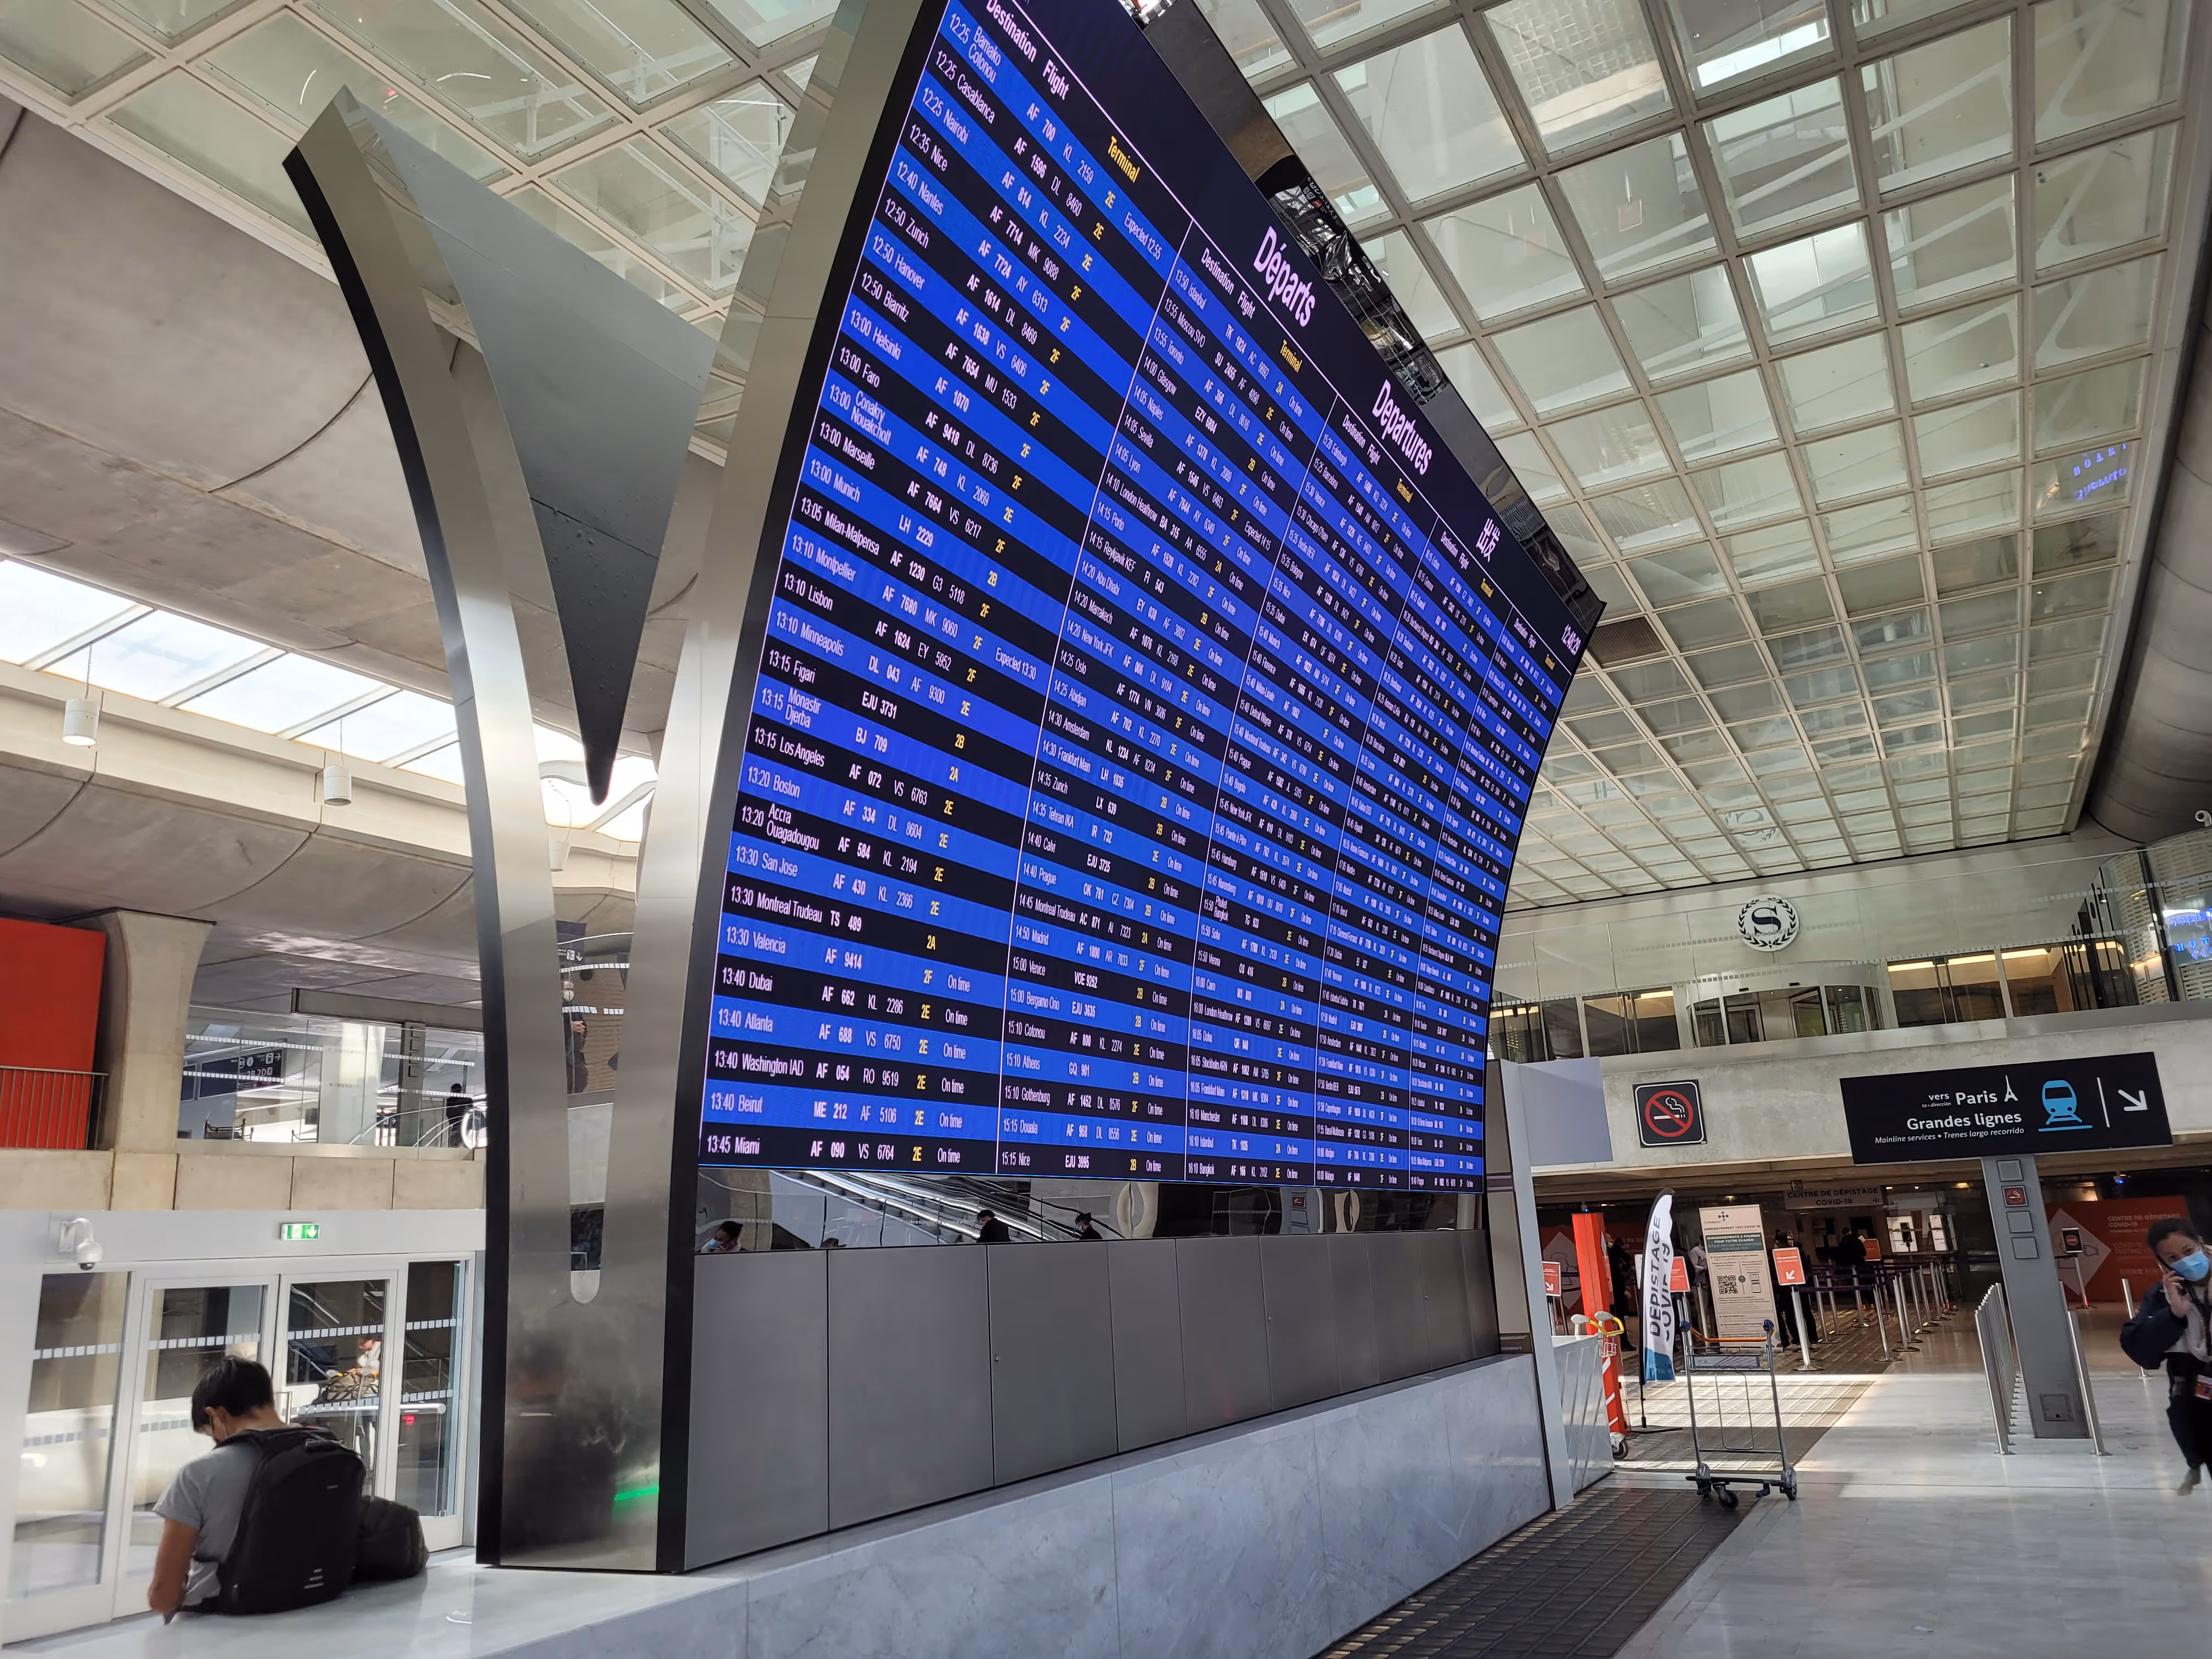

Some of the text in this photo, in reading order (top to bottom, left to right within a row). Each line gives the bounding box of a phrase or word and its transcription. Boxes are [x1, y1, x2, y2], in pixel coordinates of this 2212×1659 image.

[968, 43, 997, 83] Cotonou
[986, 0, 1140, 183] Destination Flight Terminal
[936, 50, 1104, 240] 12:25 Casablanca AF 1596 DL 8460 2E
[950, 13, 1163, 260] 12:25 Bamako AF 700 KL 2159 2E Expected 12:55
[1253, 225, 1316, 327] Départs
[1201, 247, 1302, 373] Destination Flight Terminal
[1372, 379, 1432, 475] Departures
[1342, 414, 1413, 503] Destination Flight Terminal
[820, 422, 1006, 554] 13:00 Marseille AF 7664 VS 6217 2F
[1476, 518, 1500, 562] 出发
[776, 611, 970, 716] 13:10 Minneapolis DL 043 AF 9300 2E
[726, 926, 970, 992] 13:30 Valencia AF 9414 2F On time
[1016, 924, 1030, 940] 14:50
[1031, 929, 1049, 945] Madrid
[1076, 941, 1085, 955] AF
[1105, 950, 1113, 963] AR
[1117, 953, 1128, 967] 7833
[1138, 959, 1146, 971] 2F
[1154, 963, 1161, 976] On
[1161, 966, 1170, 979] time
[715, 1050, 964, 1094] 13:40 Washington IAD AF 054 RO 9519 2E On time
[711, 1092, 962, 1128] 13:40 Beirut ME 212 AF 5106 2E On time
[1005, 1085, 1163, 1116] 15:10 Gothenburg AF 1452 DL 8576 2F On time
[1907, 1113, 2022, 1130] Grandes lignes
[1955, 1090, 1998, 1105] Paris
[707, 1135, 961, 1163] 13:45 Miami AF 090 VS 6764 2E On time
[1875, 1136, 1906, 1144] Mainline
[1908, 1133, 1936, 1142] services
[1990, 1127, 2024, 1136] recorrido
[1002, 1152, 1161, 1172] 15:15 Nice EJU 3995 2B On time
[1833, 1187, 1878, 1195] DÉPISTAGE
